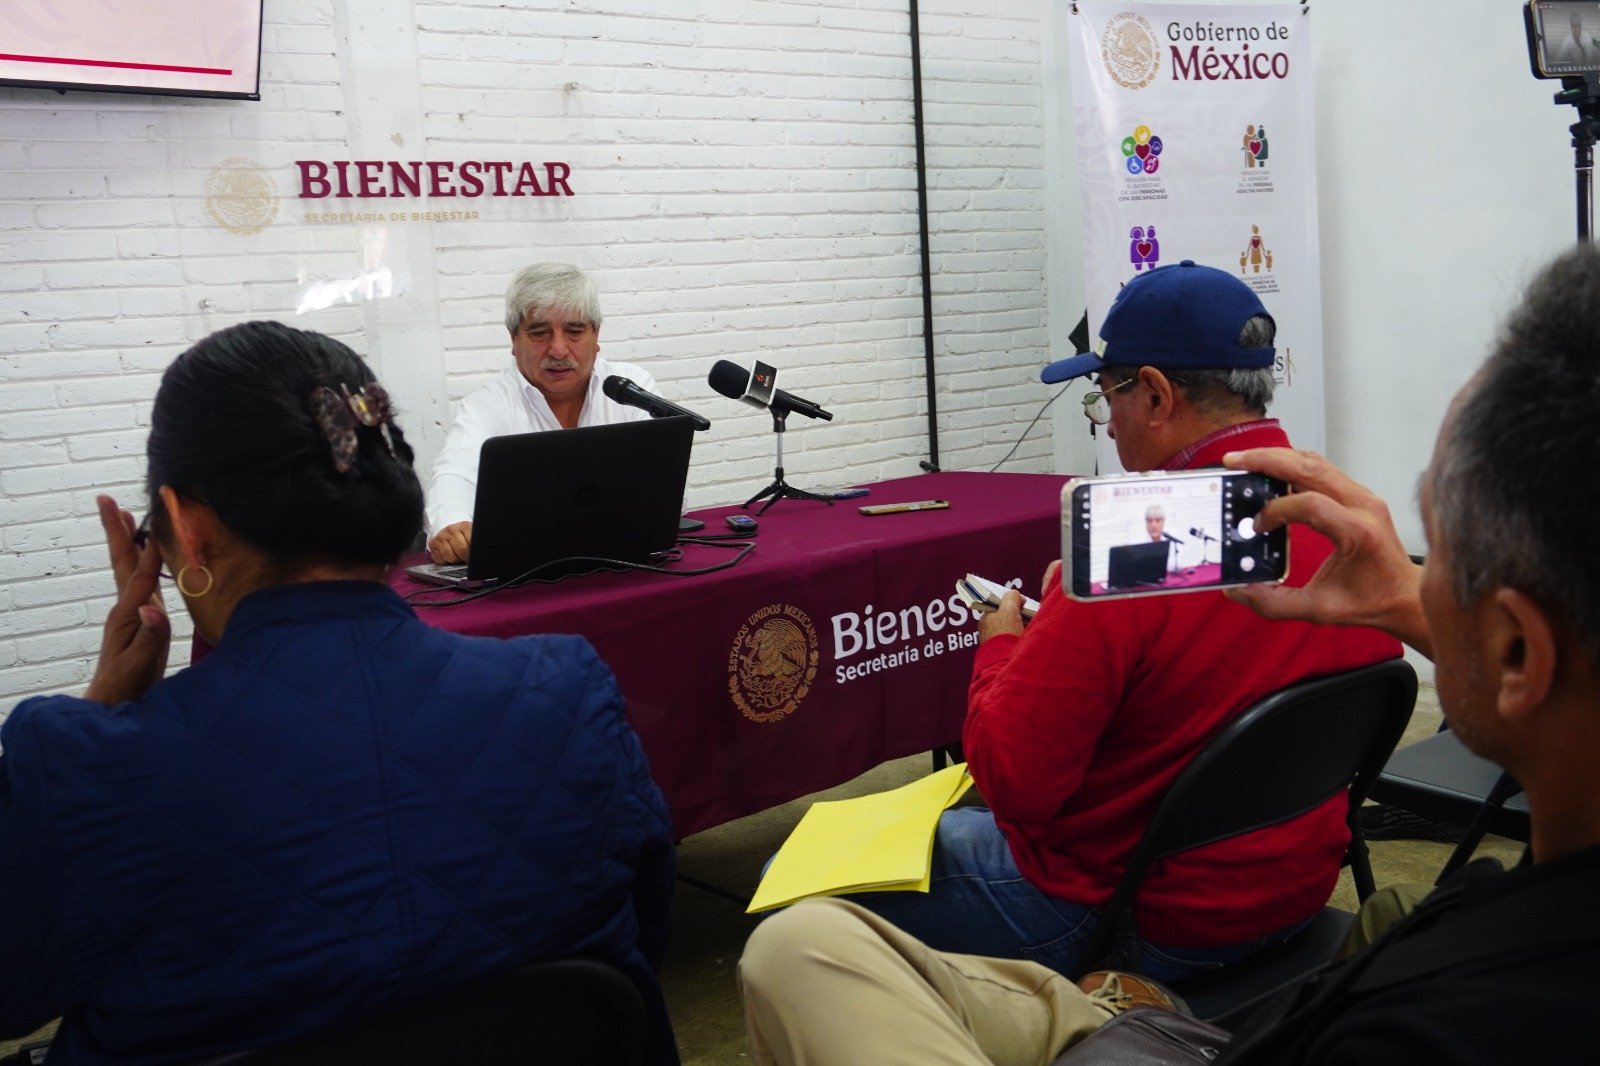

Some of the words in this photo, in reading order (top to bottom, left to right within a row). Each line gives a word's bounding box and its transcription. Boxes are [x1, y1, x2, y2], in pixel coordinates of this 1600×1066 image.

[1167, 22, 1260, 42] Gobierno
[1266, 21, 1289, 40] de
[1169, 43, 1289, 80] México
[296, 160, 575, 199] BIENESTAR
[390, 212, 407, 221] DE
[411, 211, 481, 221] BIENESTAR
[728, 624, 749, 672] ESTADOS
[748, 604, 781, 625] UNIDOS
[923, 638, 944, 658] de
